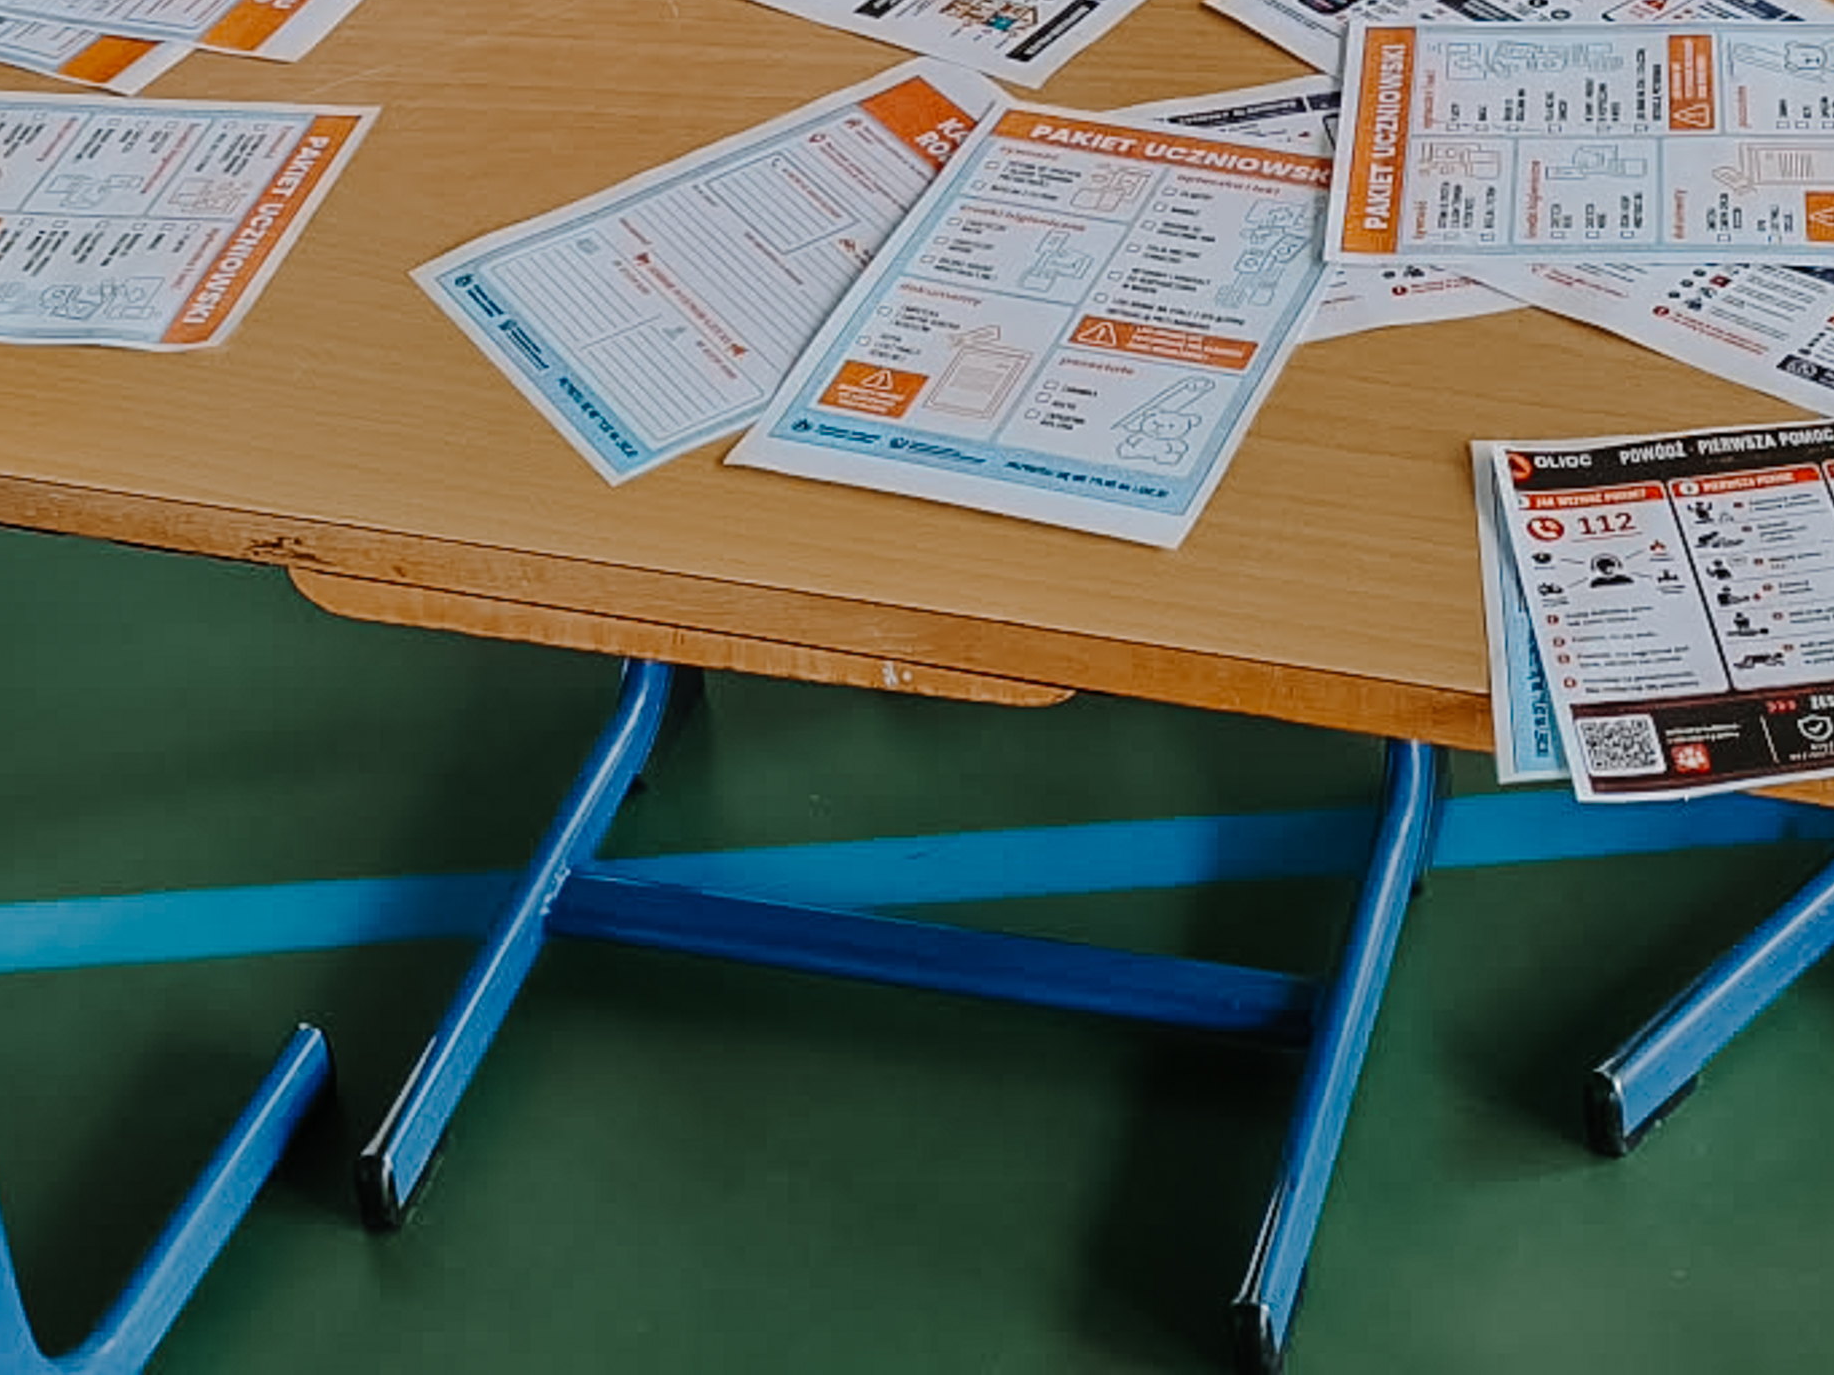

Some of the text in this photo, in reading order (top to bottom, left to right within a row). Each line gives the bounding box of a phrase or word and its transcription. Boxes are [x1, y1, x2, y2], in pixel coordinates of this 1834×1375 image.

[1030, 123, 1331, 186] PAKIET UCZNIOWSK
[1364, 44, 1406, 229] PAKIET UCZNIOWSKI
[182, 136, 331, 323] PAKIET UCZNIOWSKI
[1696, 432, 1778, 458] PIERWSZA
[1577, 511, 1637, 536] 112
